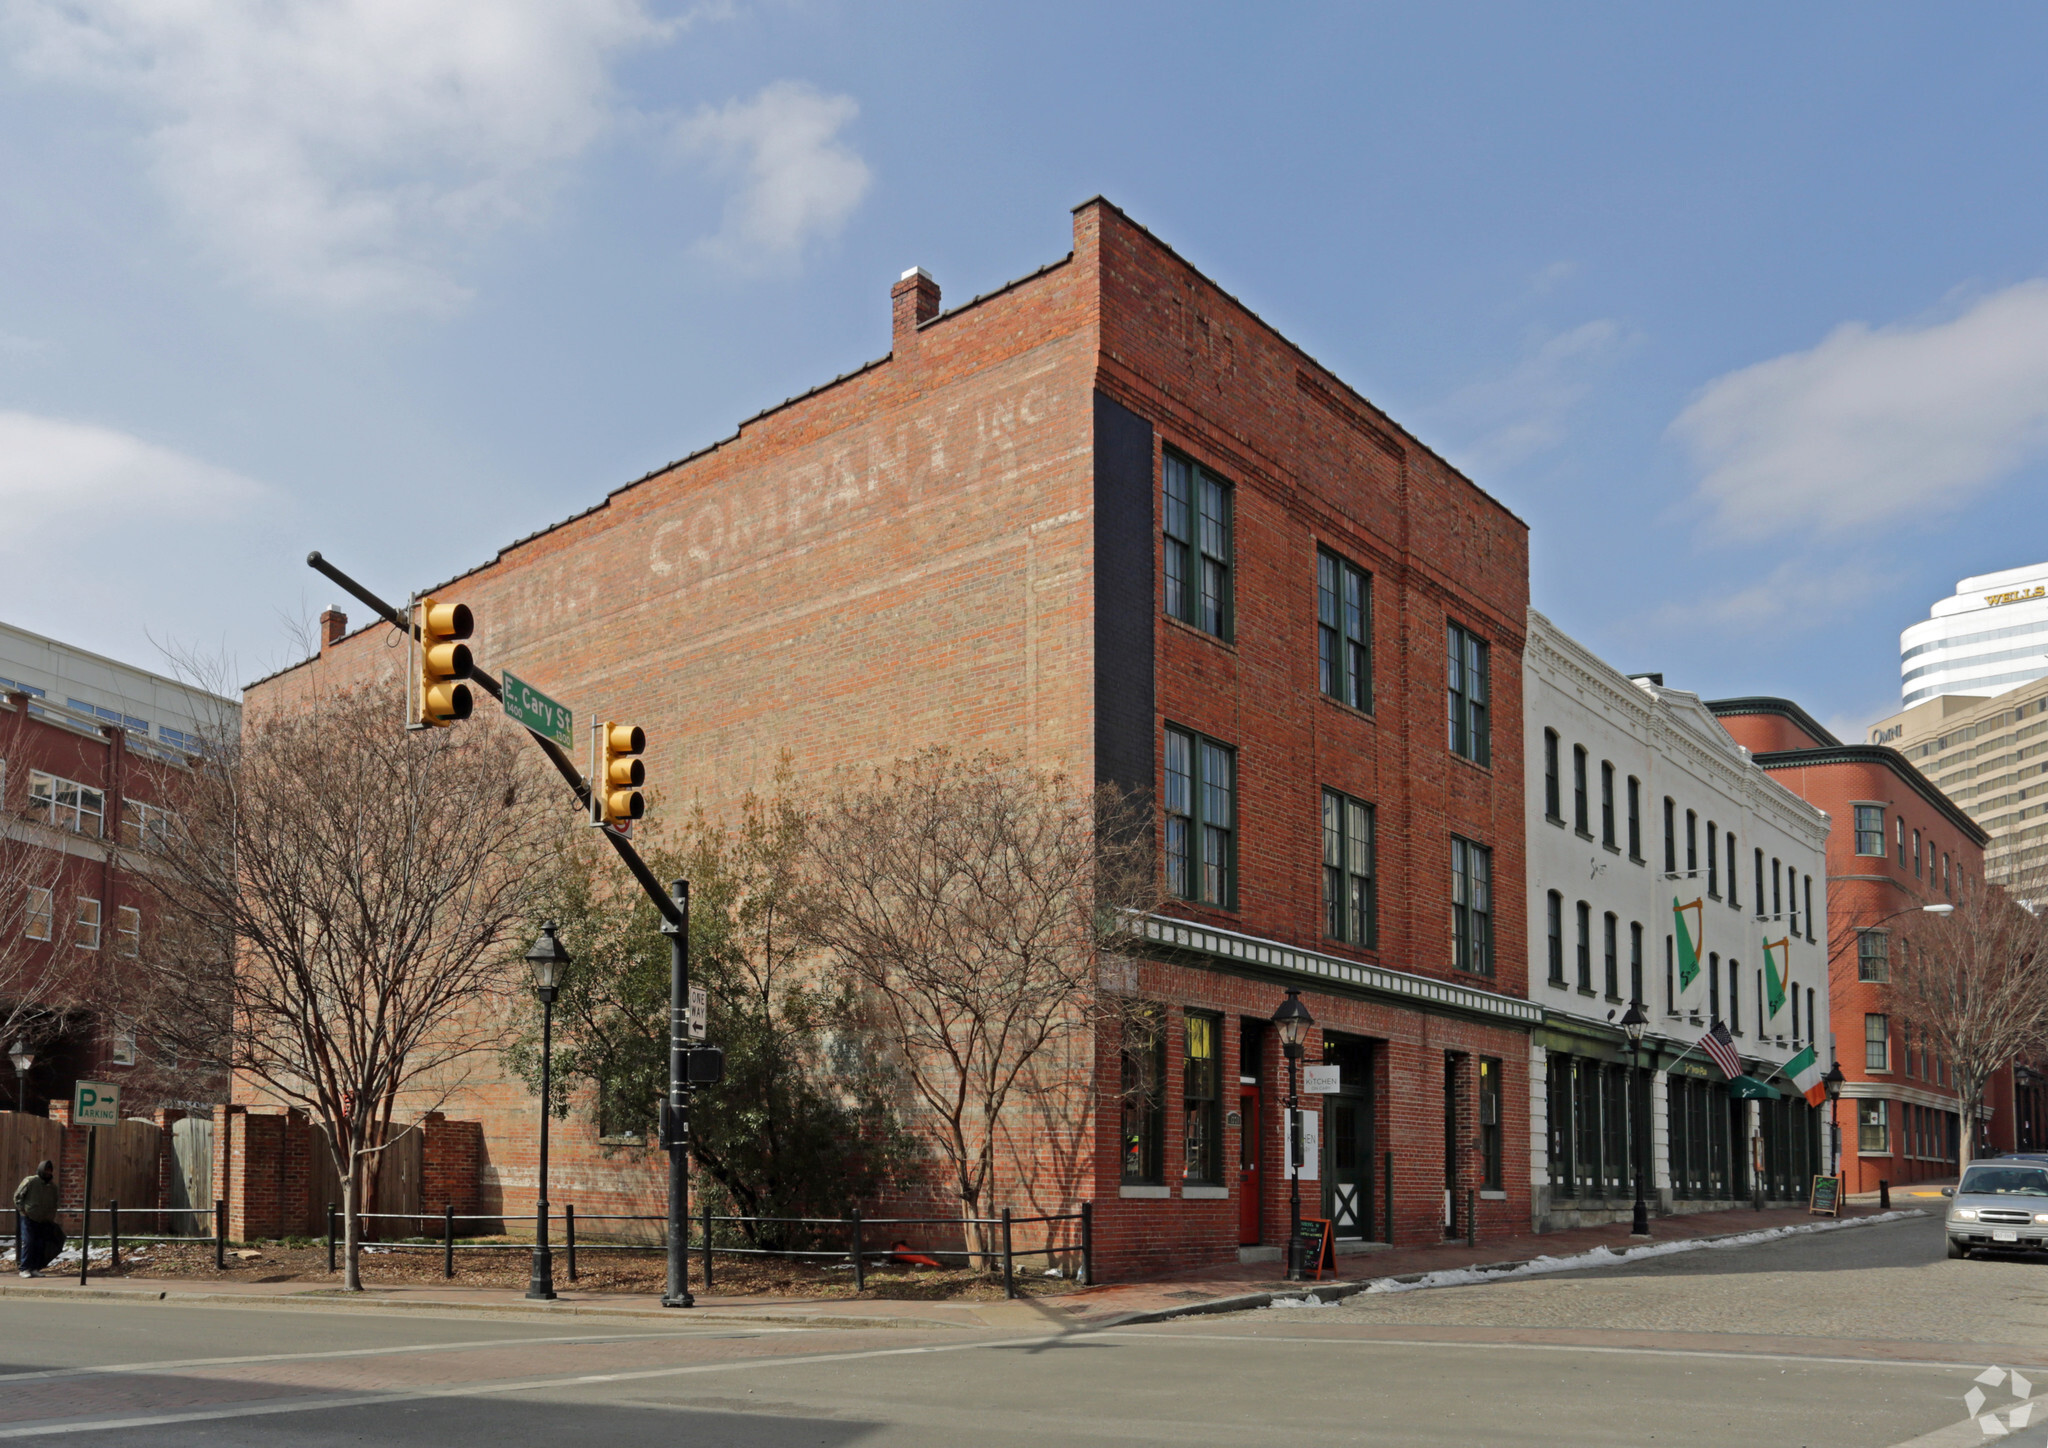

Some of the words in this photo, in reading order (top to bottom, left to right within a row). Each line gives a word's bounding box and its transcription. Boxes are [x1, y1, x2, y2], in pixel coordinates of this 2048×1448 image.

[1984, 586, 2046, 606] WELLS
[505, 676, 518, 702] E.
[522, 687, 552, 726] Cary
[557, 707, 571, 733] St
[507, 702, 523, 719] 1400
[692, 991, 704, 1005] ONE
[691, 1006, 704, 1018] WAY
[79, 1088, 114, 1119] PARKING
